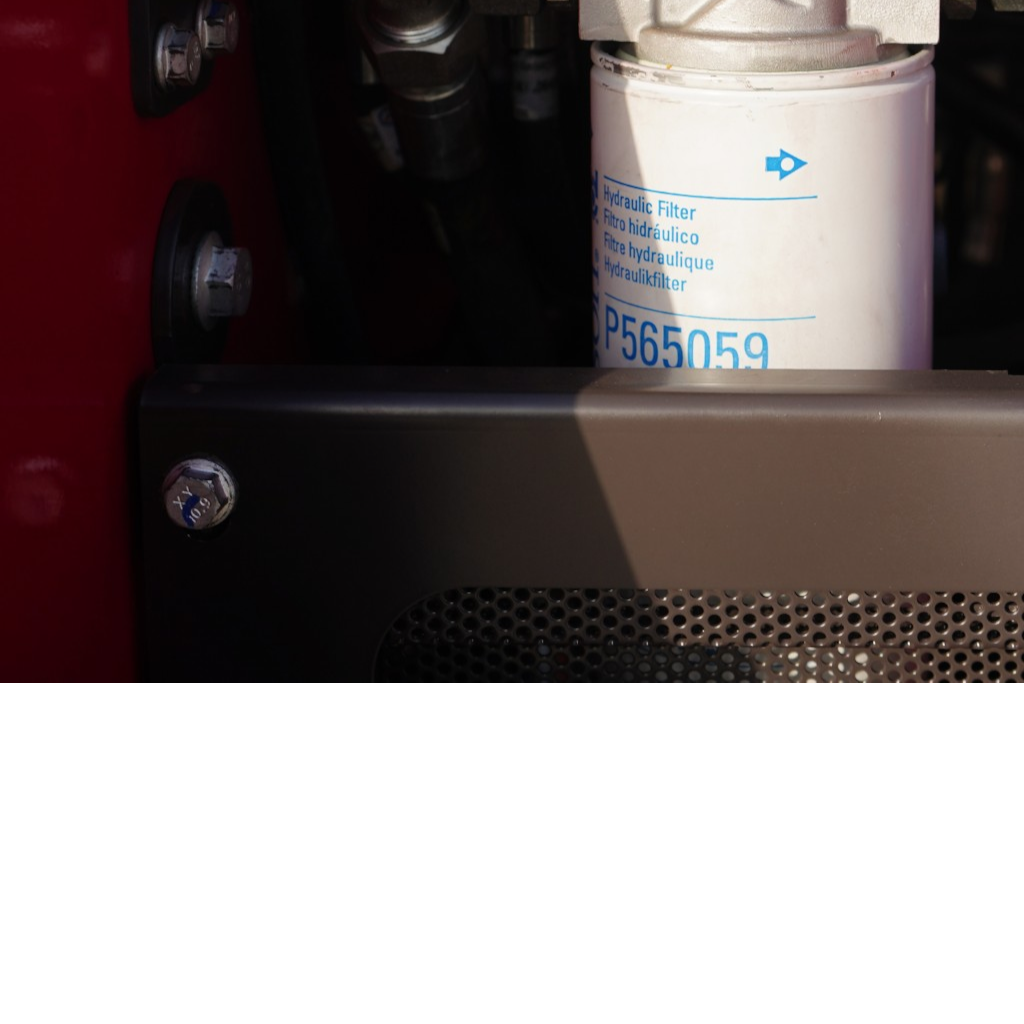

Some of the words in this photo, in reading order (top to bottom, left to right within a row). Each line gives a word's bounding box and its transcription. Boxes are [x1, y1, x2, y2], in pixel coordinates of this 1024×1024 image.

[603, 184, 653, 215] Hydraulic
[657, 199, 697, 221] Filter
[603, 208, 626, 232] Filtro
[628, 217, 700, 246] hidráulico
[603, 231, 626, 256] Filtre
[628, 241, 715, 273] hydraulique
[603, 255, 687, 292] Hydraulikfilter
[605, 304, 769, 369] P565059
[188, 497, 211, 523] 10.9
